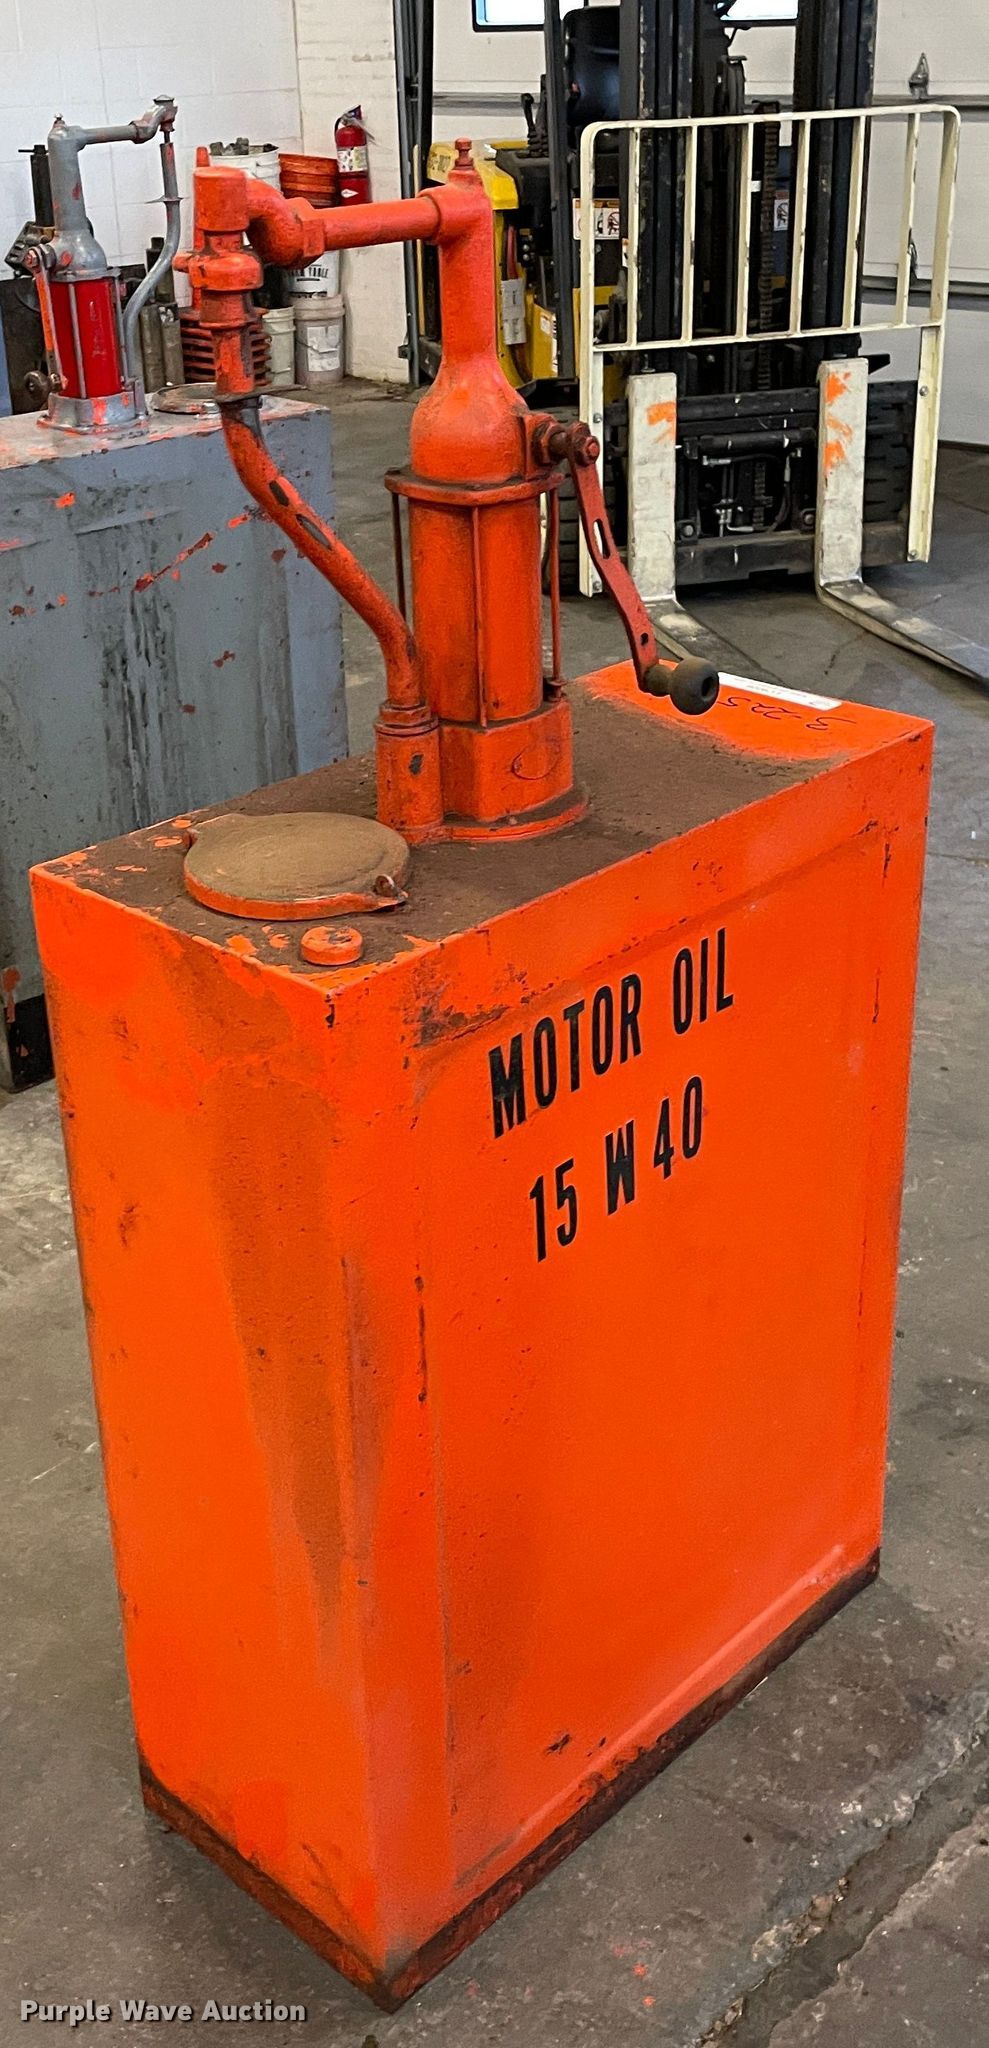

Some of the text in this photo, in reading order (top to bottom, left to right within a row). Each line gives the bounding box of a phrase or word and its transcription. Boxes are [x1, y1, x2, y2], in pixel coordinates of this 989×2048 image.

[488, 927, 734, 1140] MOTOR OIL
[529, 1075, 703, 1263] 15 W 40
